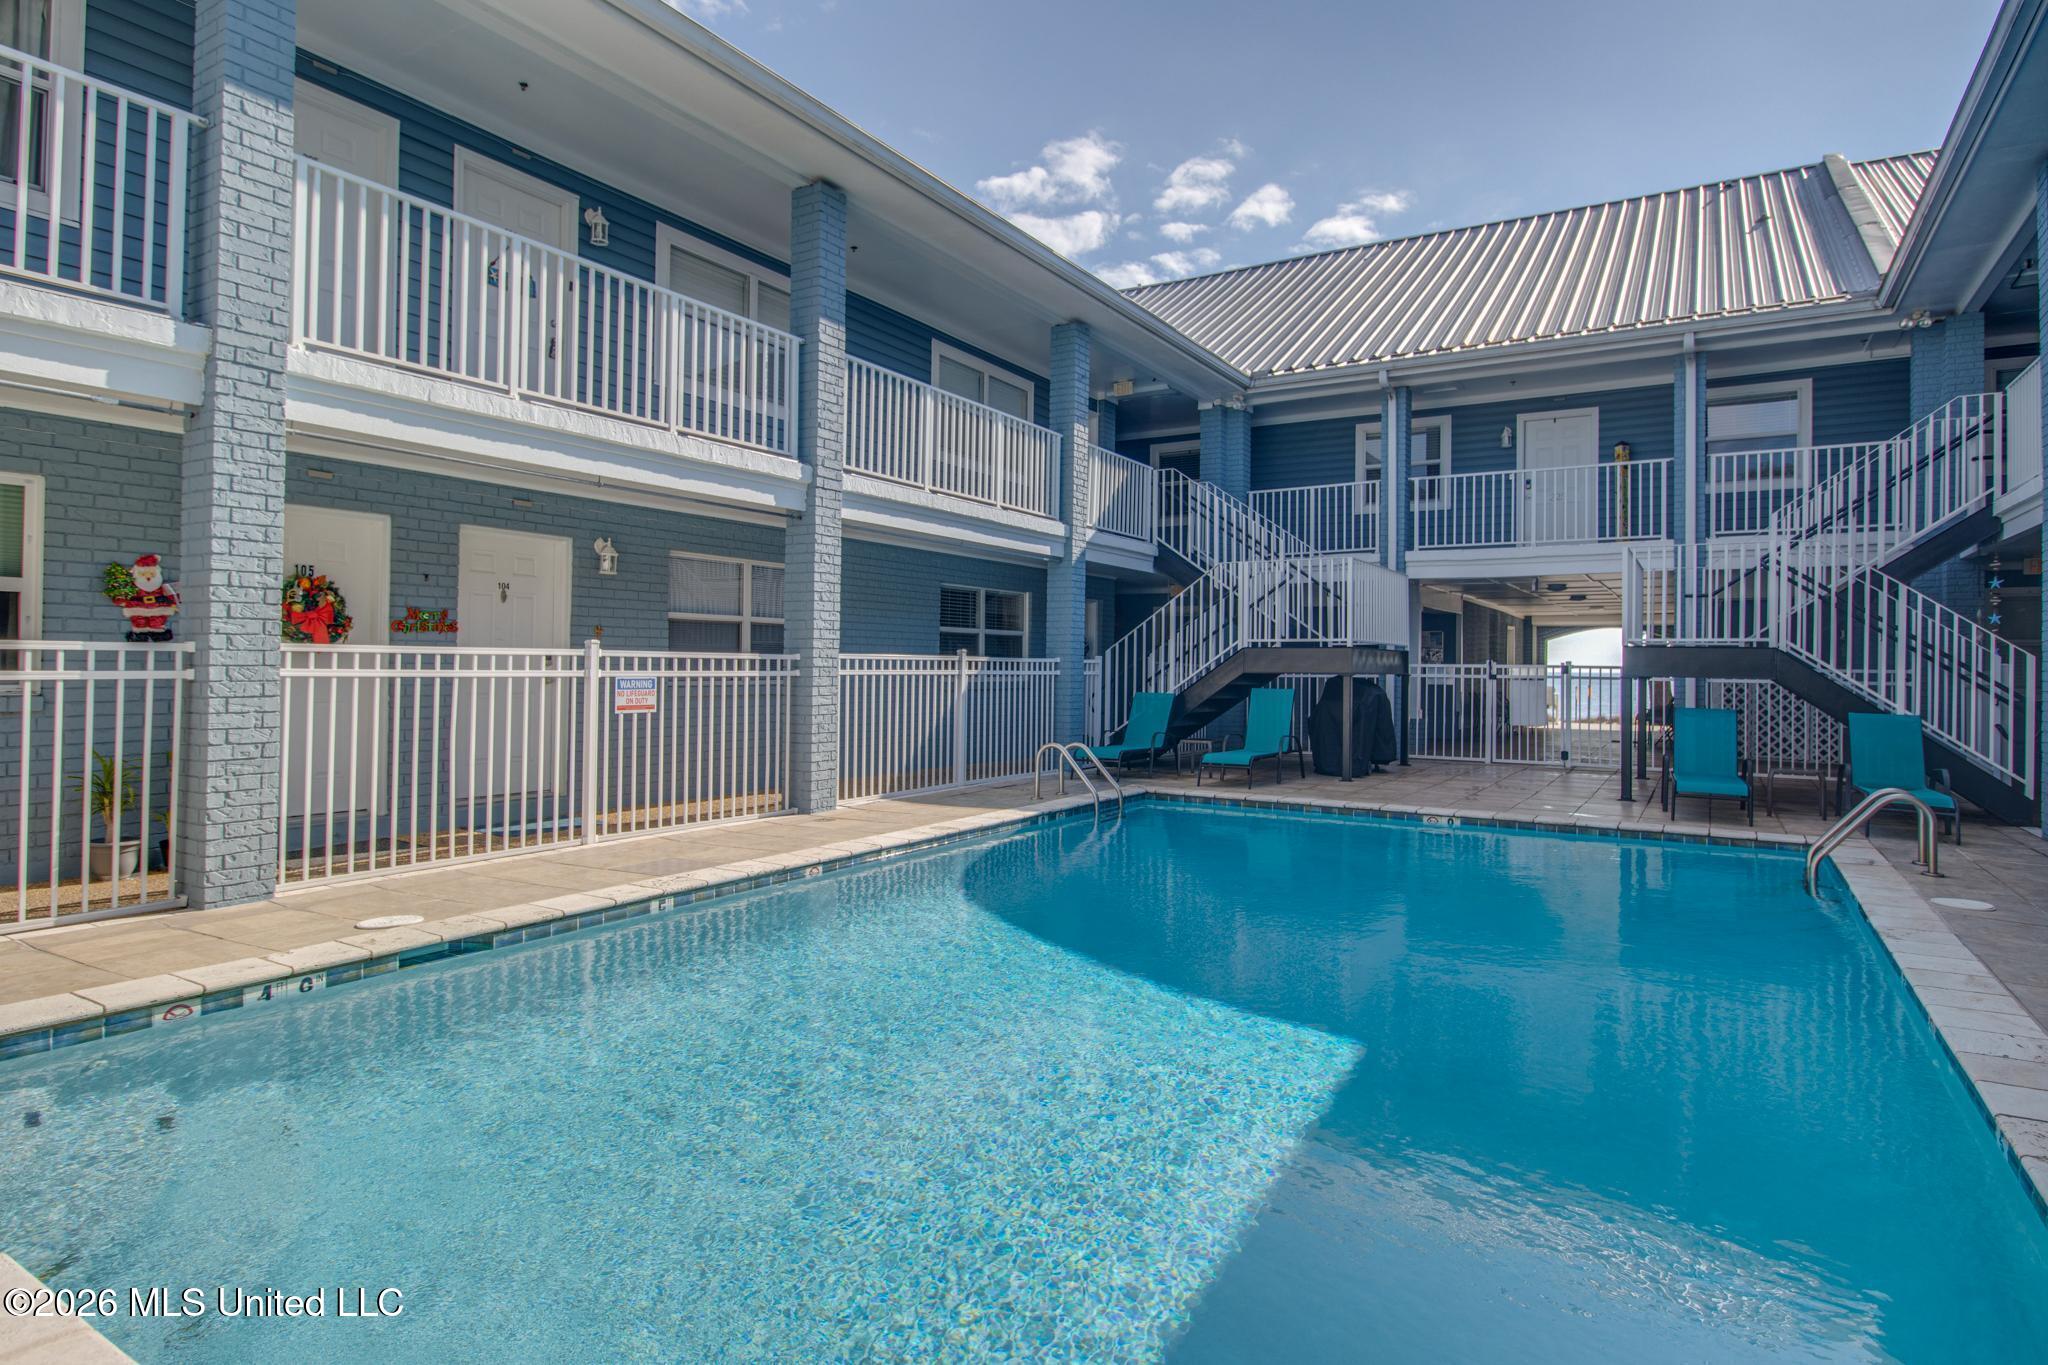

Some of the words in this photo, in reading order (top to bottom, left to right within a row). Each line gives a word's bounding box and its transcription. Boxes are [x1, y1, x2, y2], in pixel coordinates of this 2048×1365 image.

[294, 564, 314, 577] 105
[498, 582, 510, 590] 104
[620, 680, 653, 688] WARNING
[257, 984, 274, 1000] 4
